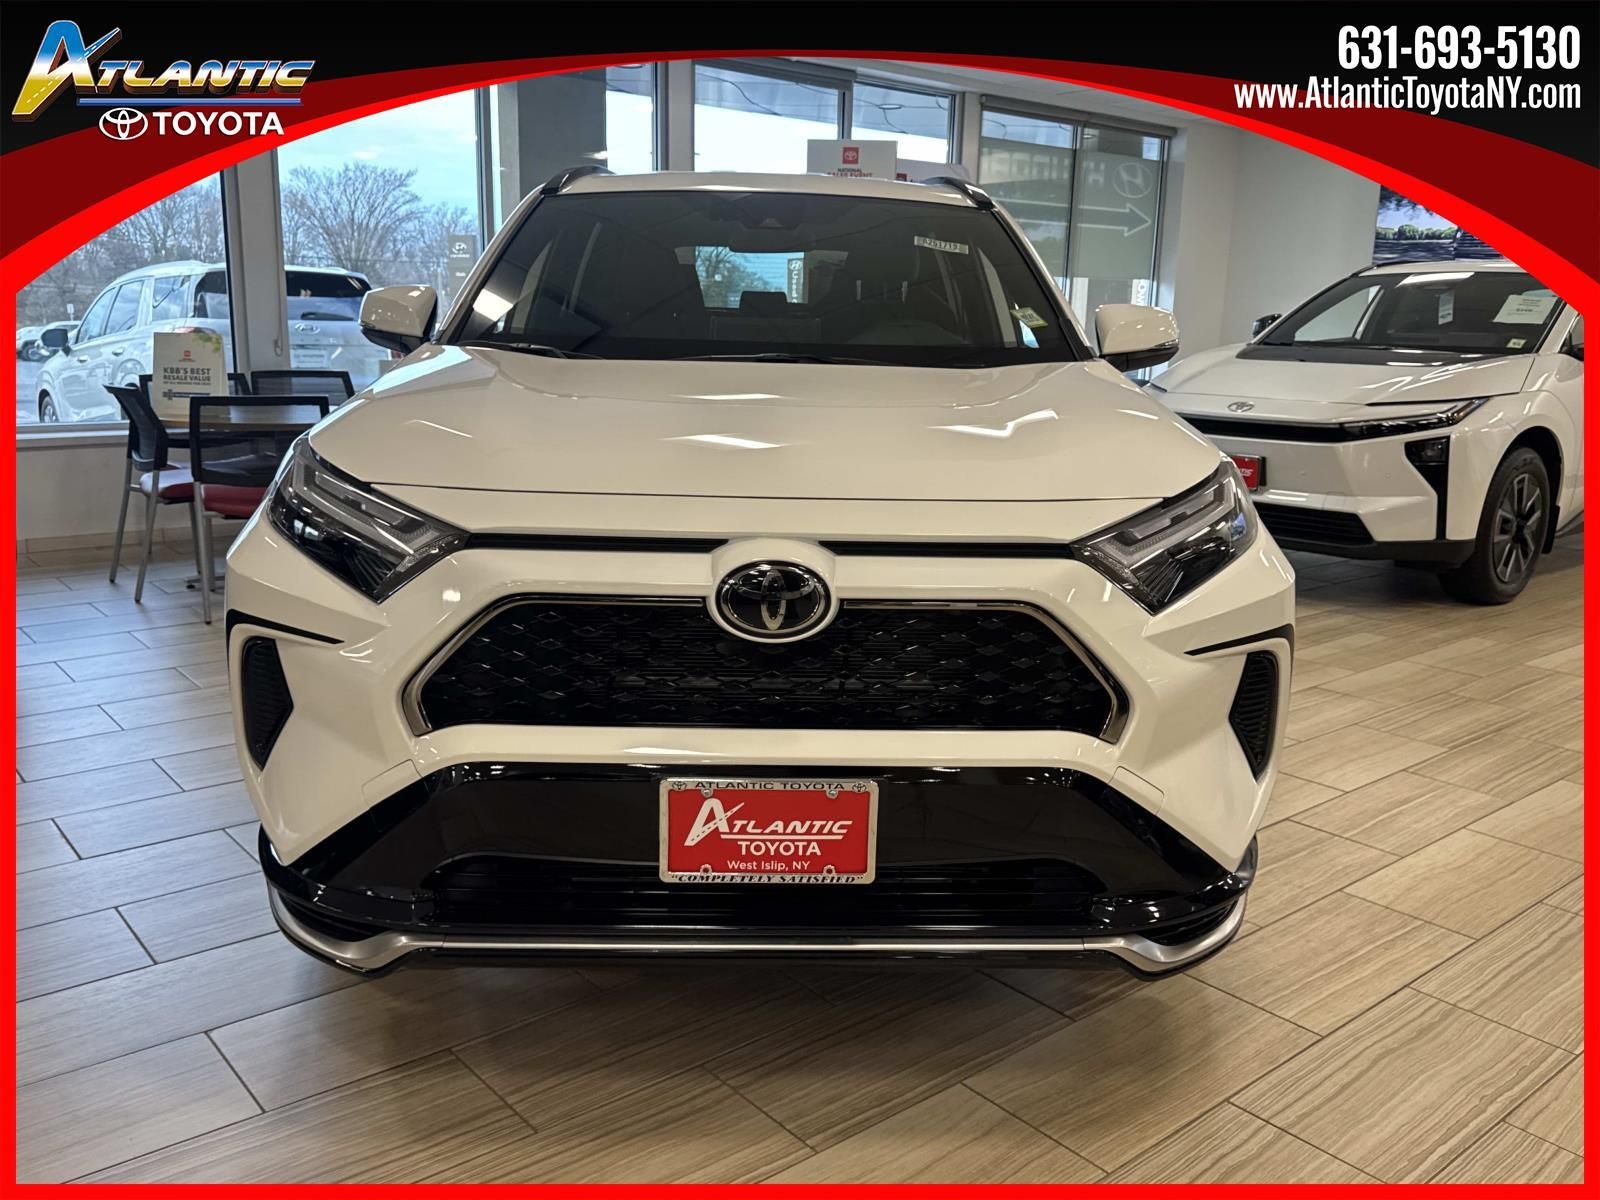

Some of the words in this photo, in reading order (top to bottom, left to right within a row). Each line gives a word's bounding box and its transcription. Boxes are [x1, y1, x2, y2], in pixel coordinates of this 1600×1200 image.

[695, 781, 774, 790] ATLANTIC
[780, 782, 845, 791] TOYOTA
[684, 798, 853, 846] ATLANTIC
[737, 841, 822, 856] TOYOTA
[727, 860, 758, 871] West
[761, 860, 789, 872] Islip,
[792, 861, 811, 871] NY
